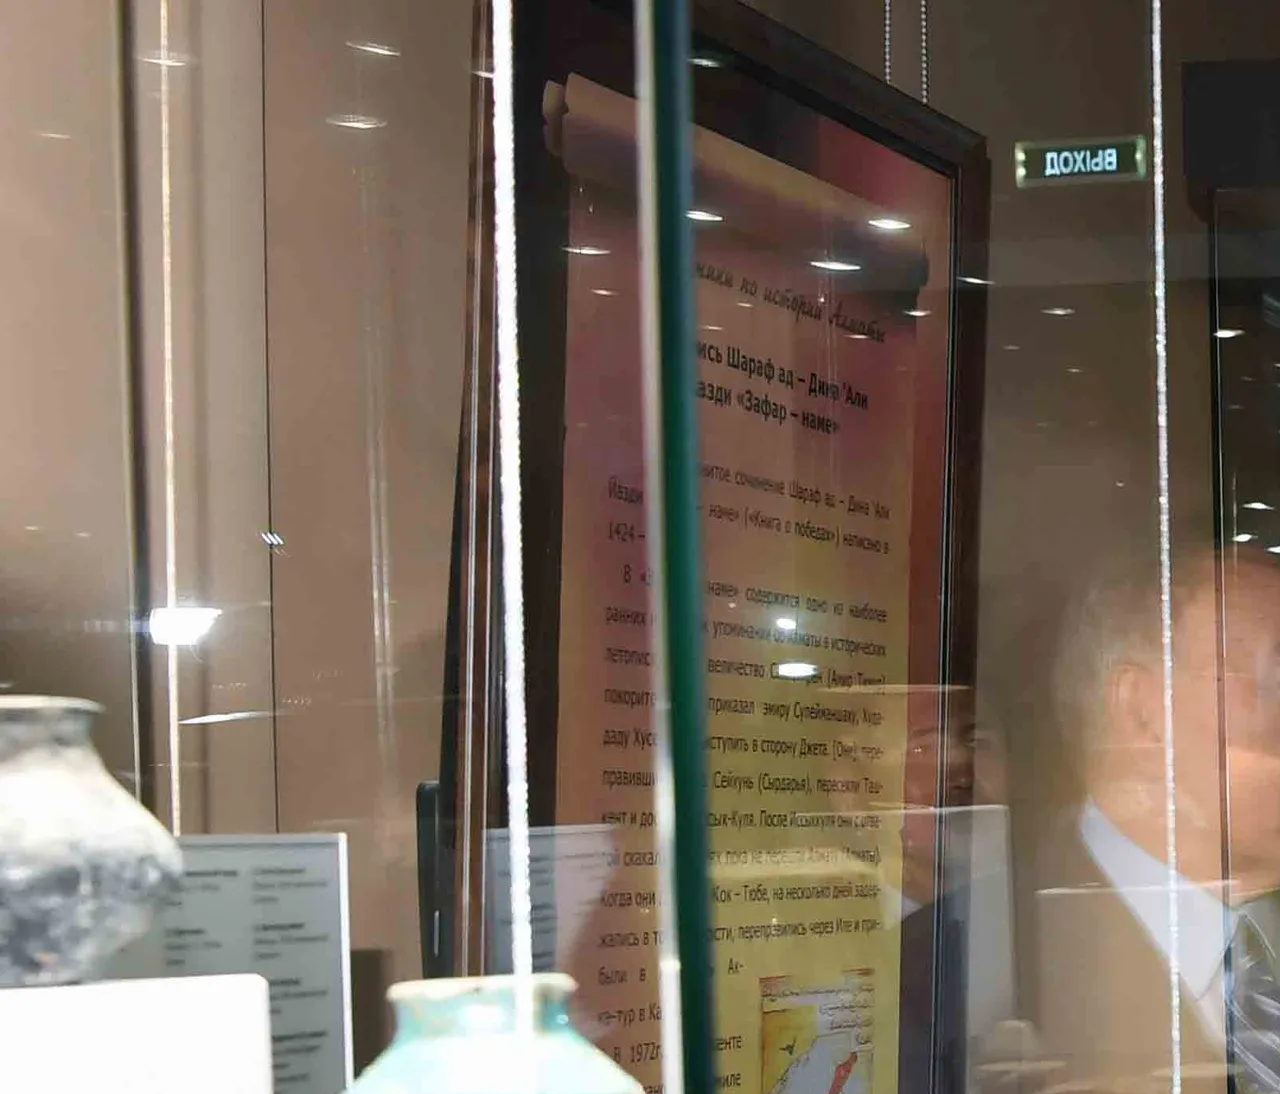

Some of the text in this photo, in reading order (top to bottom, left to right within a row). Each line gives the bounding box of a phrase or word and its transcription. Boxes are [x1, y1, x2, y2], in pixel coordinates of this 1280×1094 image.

[696, 343, 722, 364] ись
[727, 346, 775, 384] Шараф
[779, 367, 795, 390] ад
[697, 381, 732, 408] азди
[737, 389, 787, 426] «Зафар
[789, 478, 822, 508] Шараф
[608, 520, 635, 542] 1424
